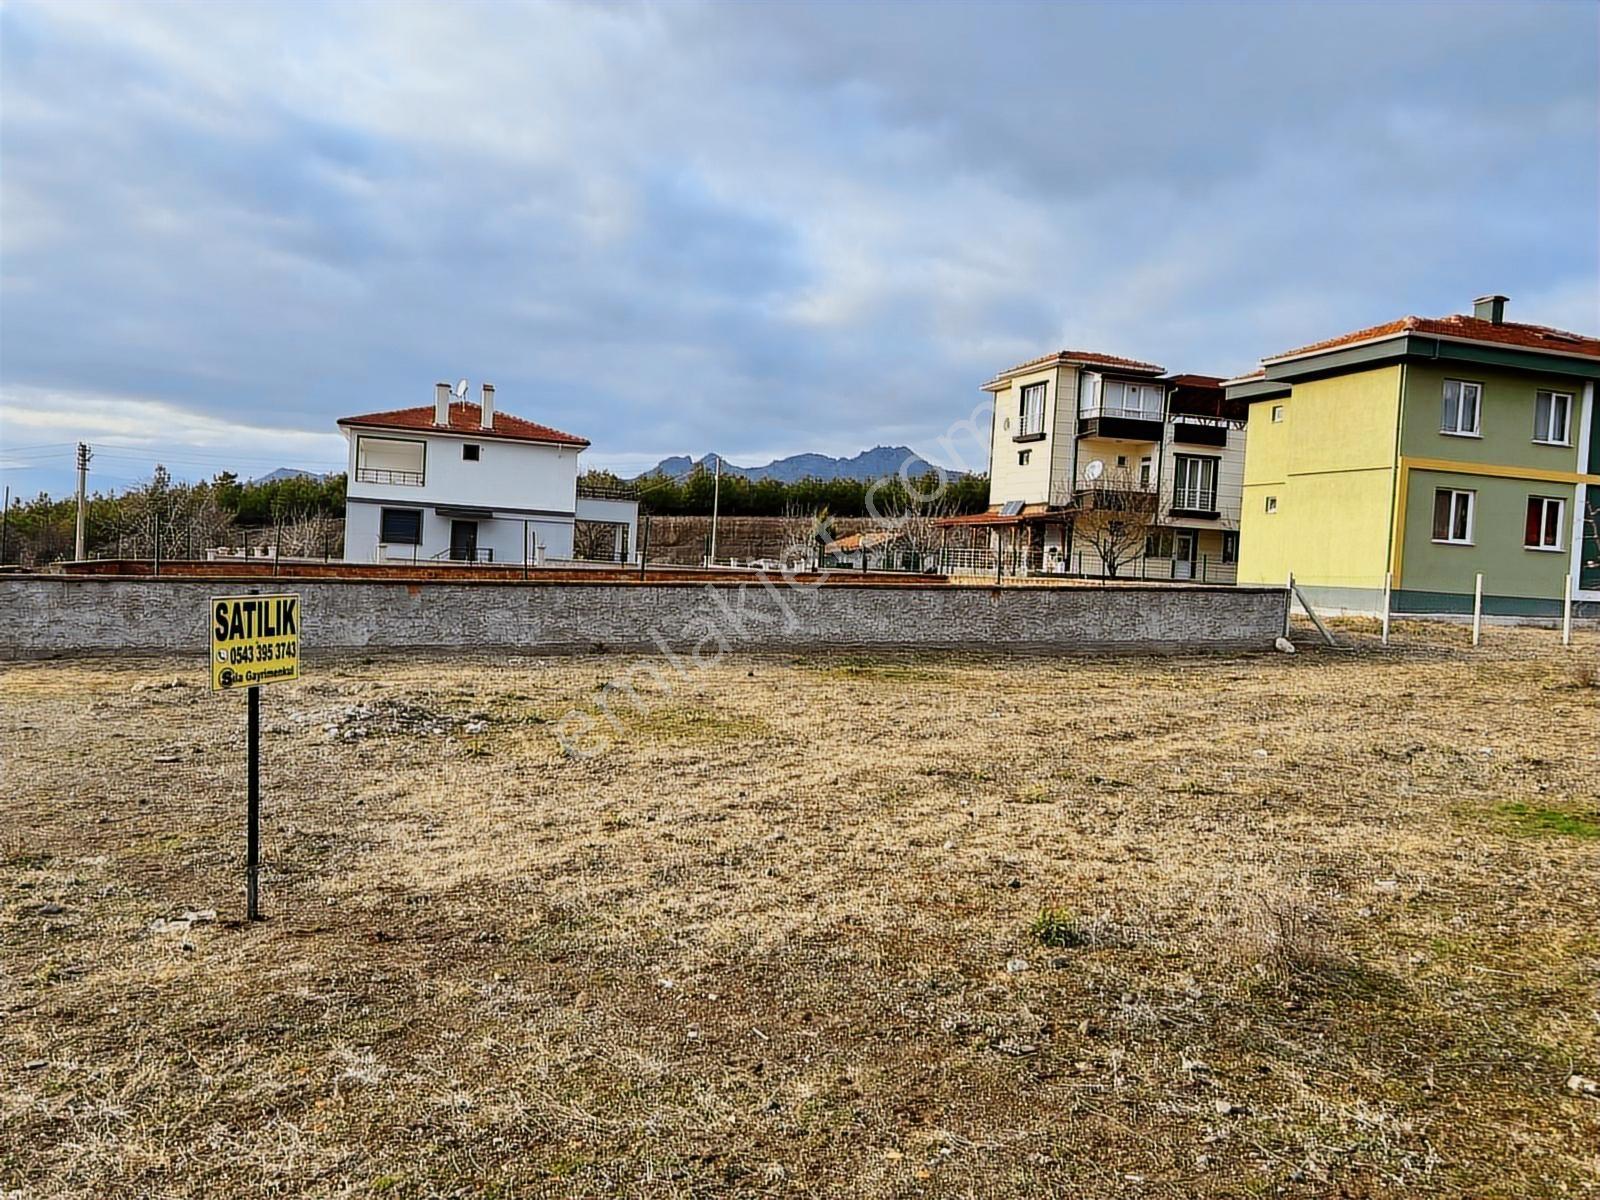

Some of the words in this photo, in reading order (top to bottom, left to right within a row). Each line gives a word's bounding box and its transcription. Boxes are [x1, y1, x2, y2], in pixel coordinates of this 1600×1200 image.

[215, 600, 296, 641] SATILIK
[230, 646, 254, 664] 0543
[256, 643, 273, 662] 395
[275, 641, 296, 660] 3743
